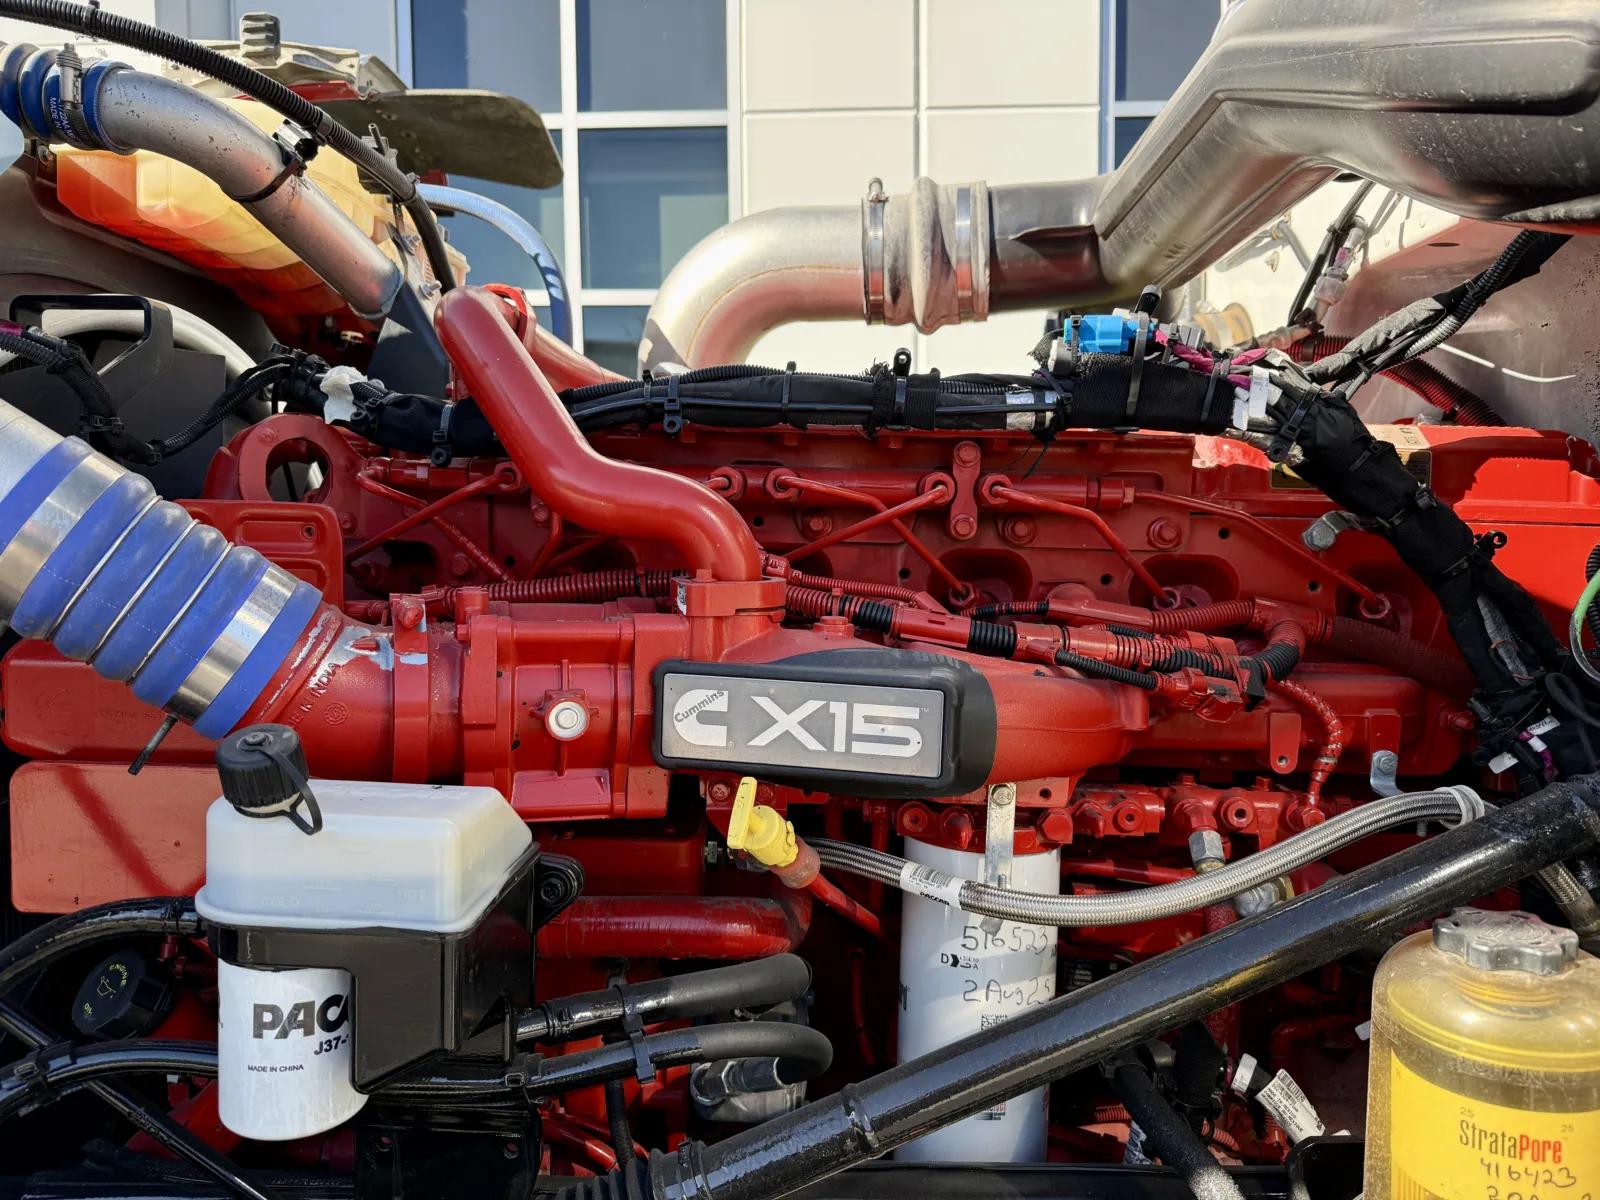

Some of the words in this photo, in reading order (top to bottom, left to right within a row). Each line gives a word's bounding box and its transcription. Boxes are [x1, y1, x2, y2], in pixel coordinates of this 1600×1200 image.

[309, 662, 337, 698] INDIA
[674, 689, 725, 724] Cummins
[747, 695, 923, 758] X15
[109, 963, 128, 987] ENGINE
[83, 1002, 93, 1015] OIL
[313, 1033, 349, 1055] J37-
[247, 1064, 268, 1073] MADE
[269, 1064, 278, 1072] IN
[279, 1063, 304, 1072] CHINA
[1283, 1104, 1297, 1119] MEXICO
[1460, 1107, 1474, 1118] 25
[1459, 1119, 1563, 1165] StrataPore
